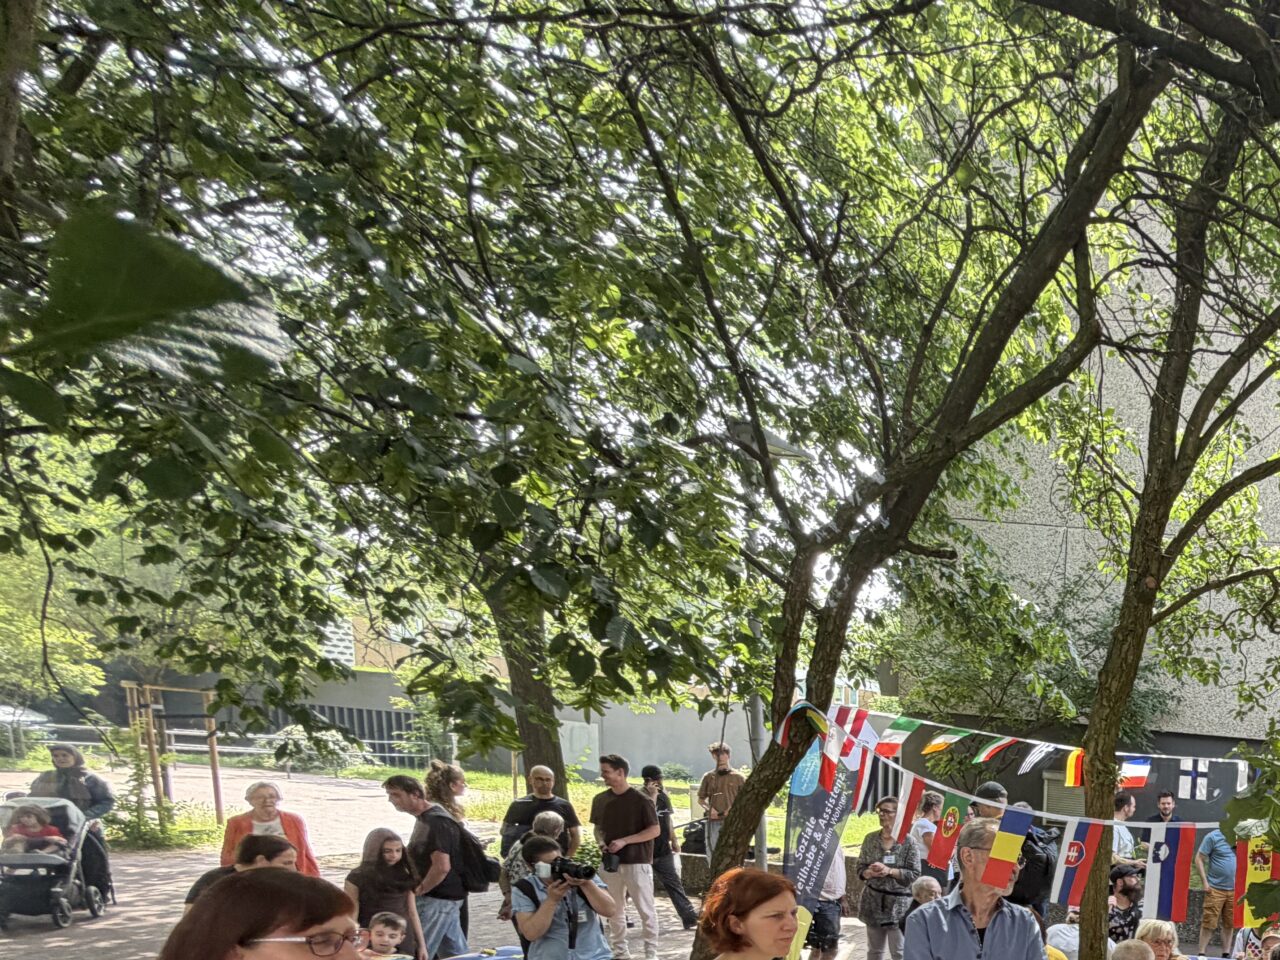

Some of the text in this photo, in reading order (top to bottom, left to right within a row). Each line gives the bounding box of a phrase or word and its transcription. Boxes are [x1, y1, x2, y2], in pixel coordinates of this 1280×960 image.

[795, 816, 817, 861] Soziale
[813, 832, 822, 841] &
[818, 772, 846, 829] Assistenz
[805, 790, 847, 894] Assistenz beim Wohnen
